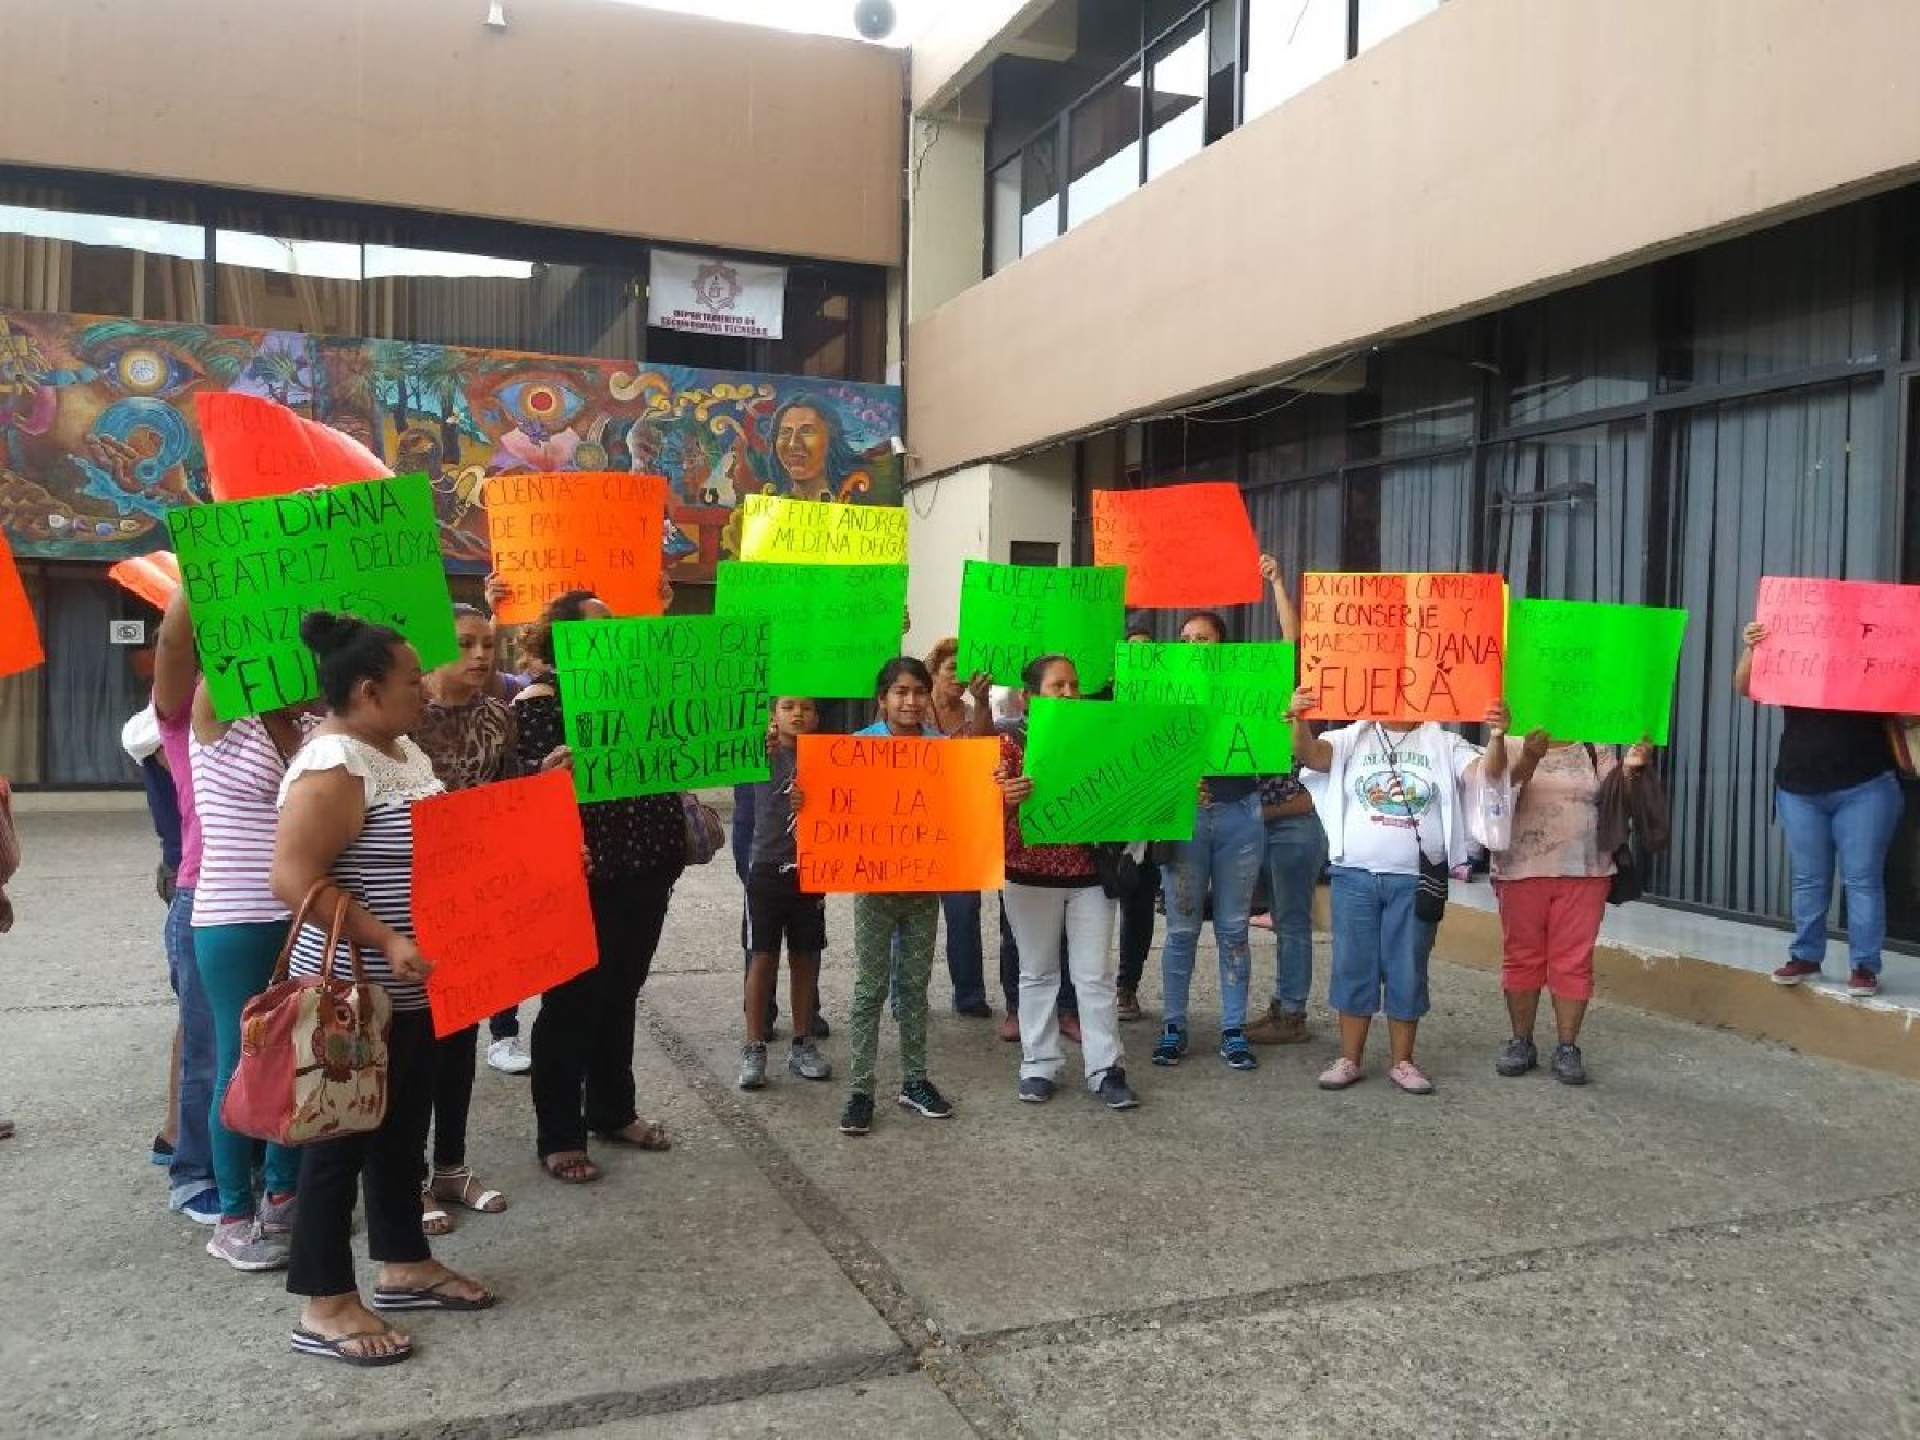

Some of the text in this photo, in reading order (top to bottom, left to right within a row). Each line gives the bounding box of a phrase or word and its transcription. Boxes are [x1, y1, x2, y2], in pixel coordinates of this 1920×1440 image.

[275, 482, 405, 536] DIANA
[837, 508, 907, 537] ANDREA
[492, 516, 516, 539] DE
[771, 527, 851, 553] MEDINA
[184, 543, 335, 604] BEATRIZ
[608, 550, 635, 570] EN
[1305, 575, 1405, 600] EXIGIMOS
[198, 589, 387, 653] GONZES
[1305, 602, 1472, 631] DE CONSERJE Y
[564, 621, 701, 660] EXIGIMOS
[719, 622, 769, 657] QUE
[1304, 630, 1504, 667] MAESTRA DIANA
[562, 663, 660, 699] TOMEN
[1320, 665, 1460, 716] FUERA
[584, 756, 599, 794] Y
[829, 788, 930, 816] DE LA
